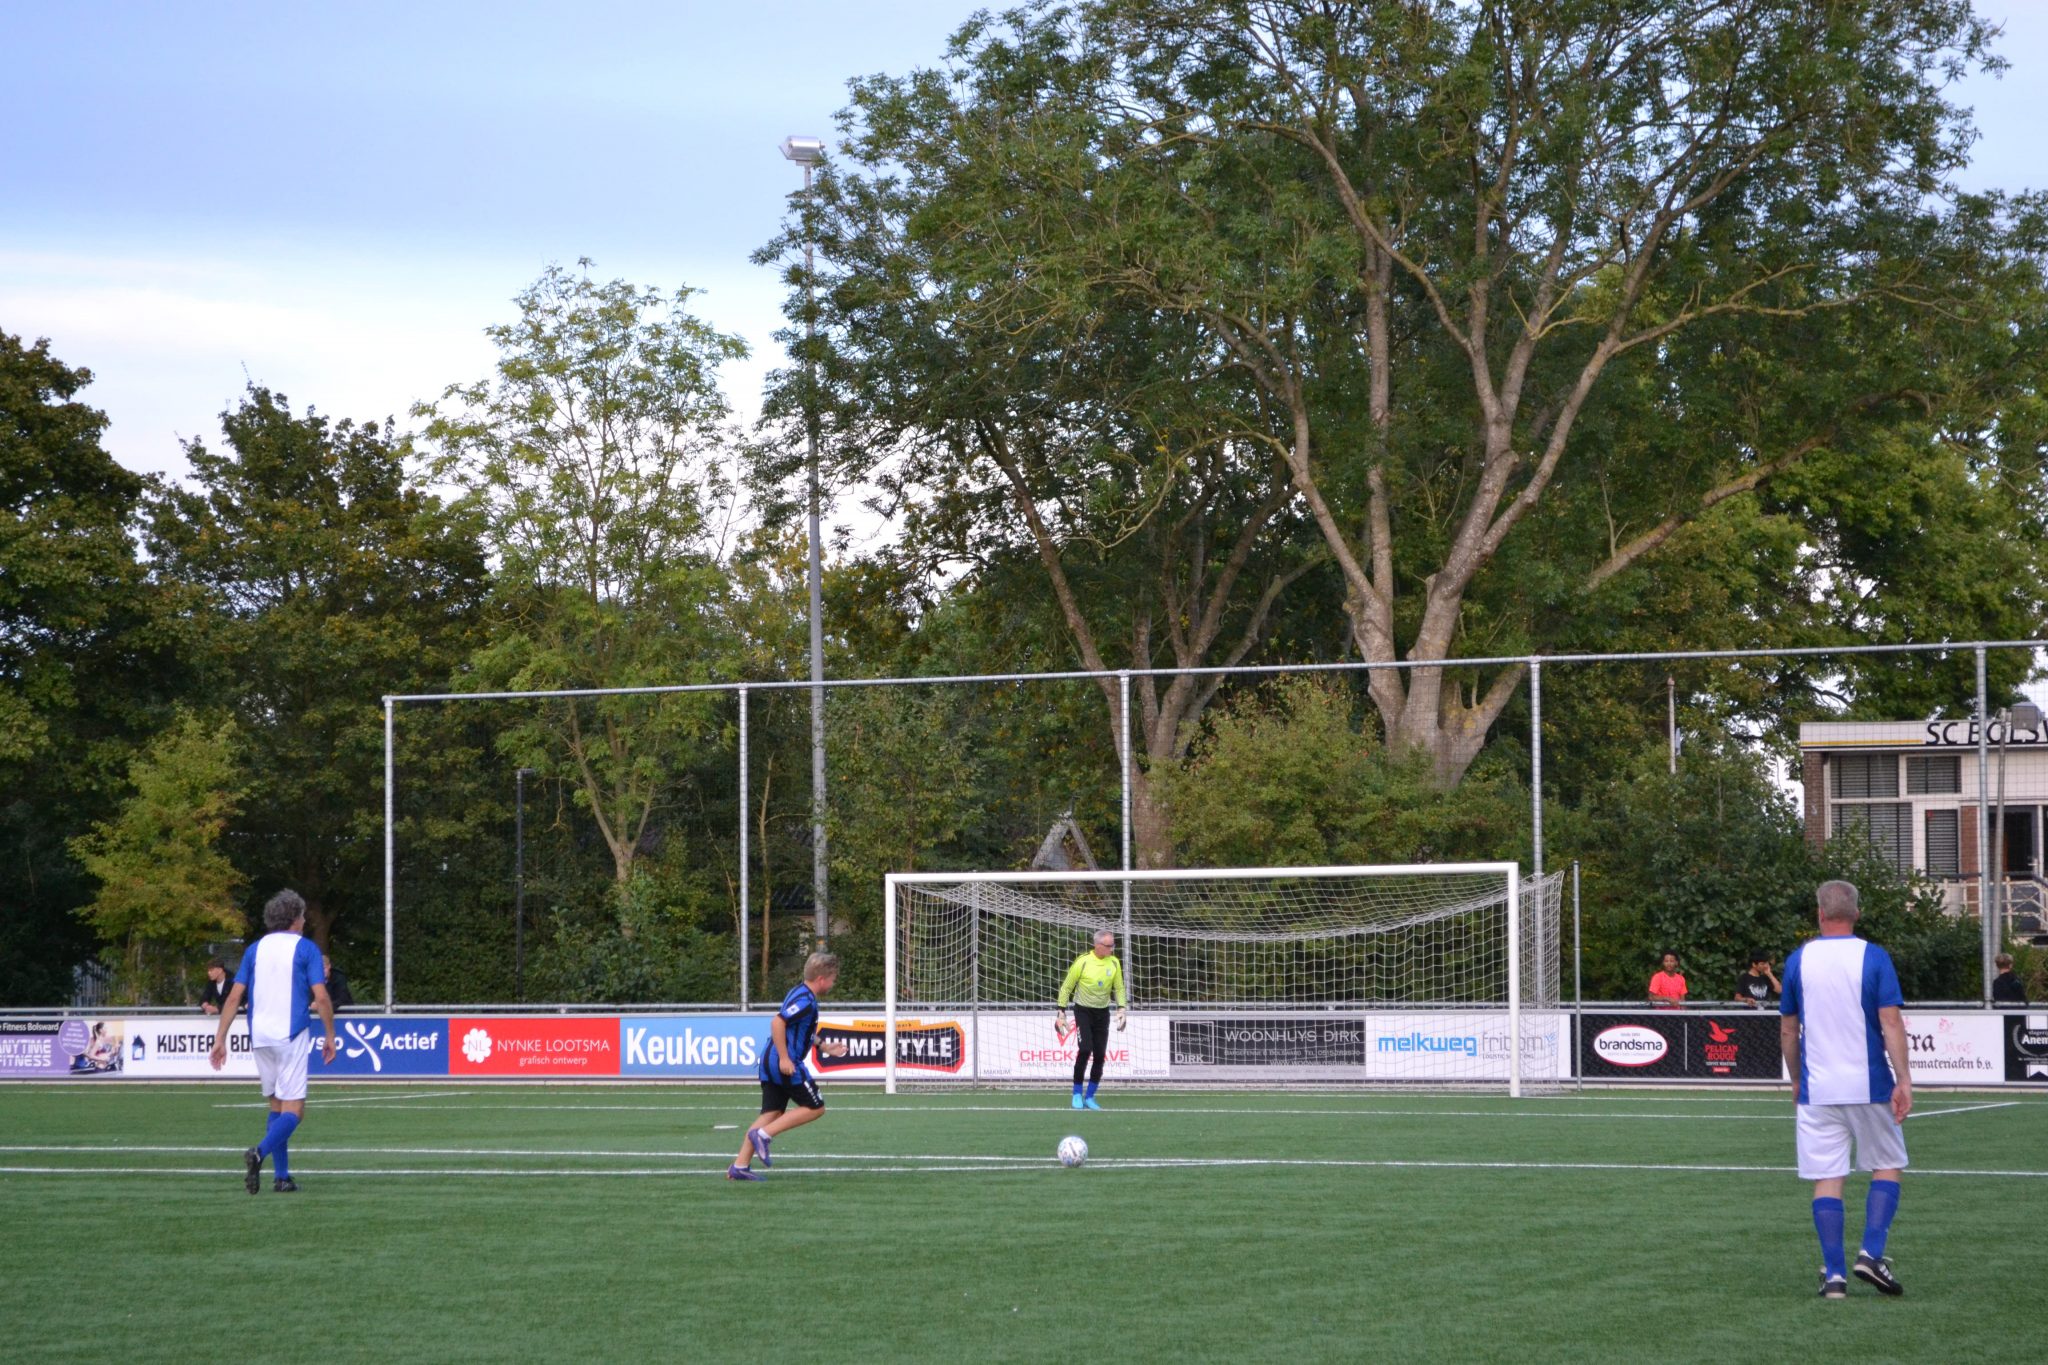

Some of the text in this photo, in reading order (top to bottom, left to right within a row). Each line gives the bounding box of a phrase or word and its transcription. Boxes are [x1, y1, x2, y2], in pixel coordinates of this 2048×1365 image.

[1926, 720, 2048, 745] SC BOLS
[3, 1022, 59, 1031] Fitness Bolsward
[380, 1032, 439, 1050] Actief
[1225, 1030, 1360, 1042] WOONHUYS DIRK
[1906, 1033, 1936, 1052] ra
[157, 1034, 254, 1053] KUSTER BO
[468, 1039, 486, 1052] NL
[497, 1039, 611, 1052] NYNKE LOOTSMA
[822, 1036, 953, 1058] JUMPTYLE
[1378, 1032, 1478, 1057] melkweg
[1600, 1038, 1663, 1051] brandsma
[1704, 1044, 1738, 1052] PELICAN
[519, 1056, 588, 1067] grafisch ontwerp
[1175, 1053, 1205, 1064] DIRK
[1708, 1053, 1736, 1061] ROUGE
